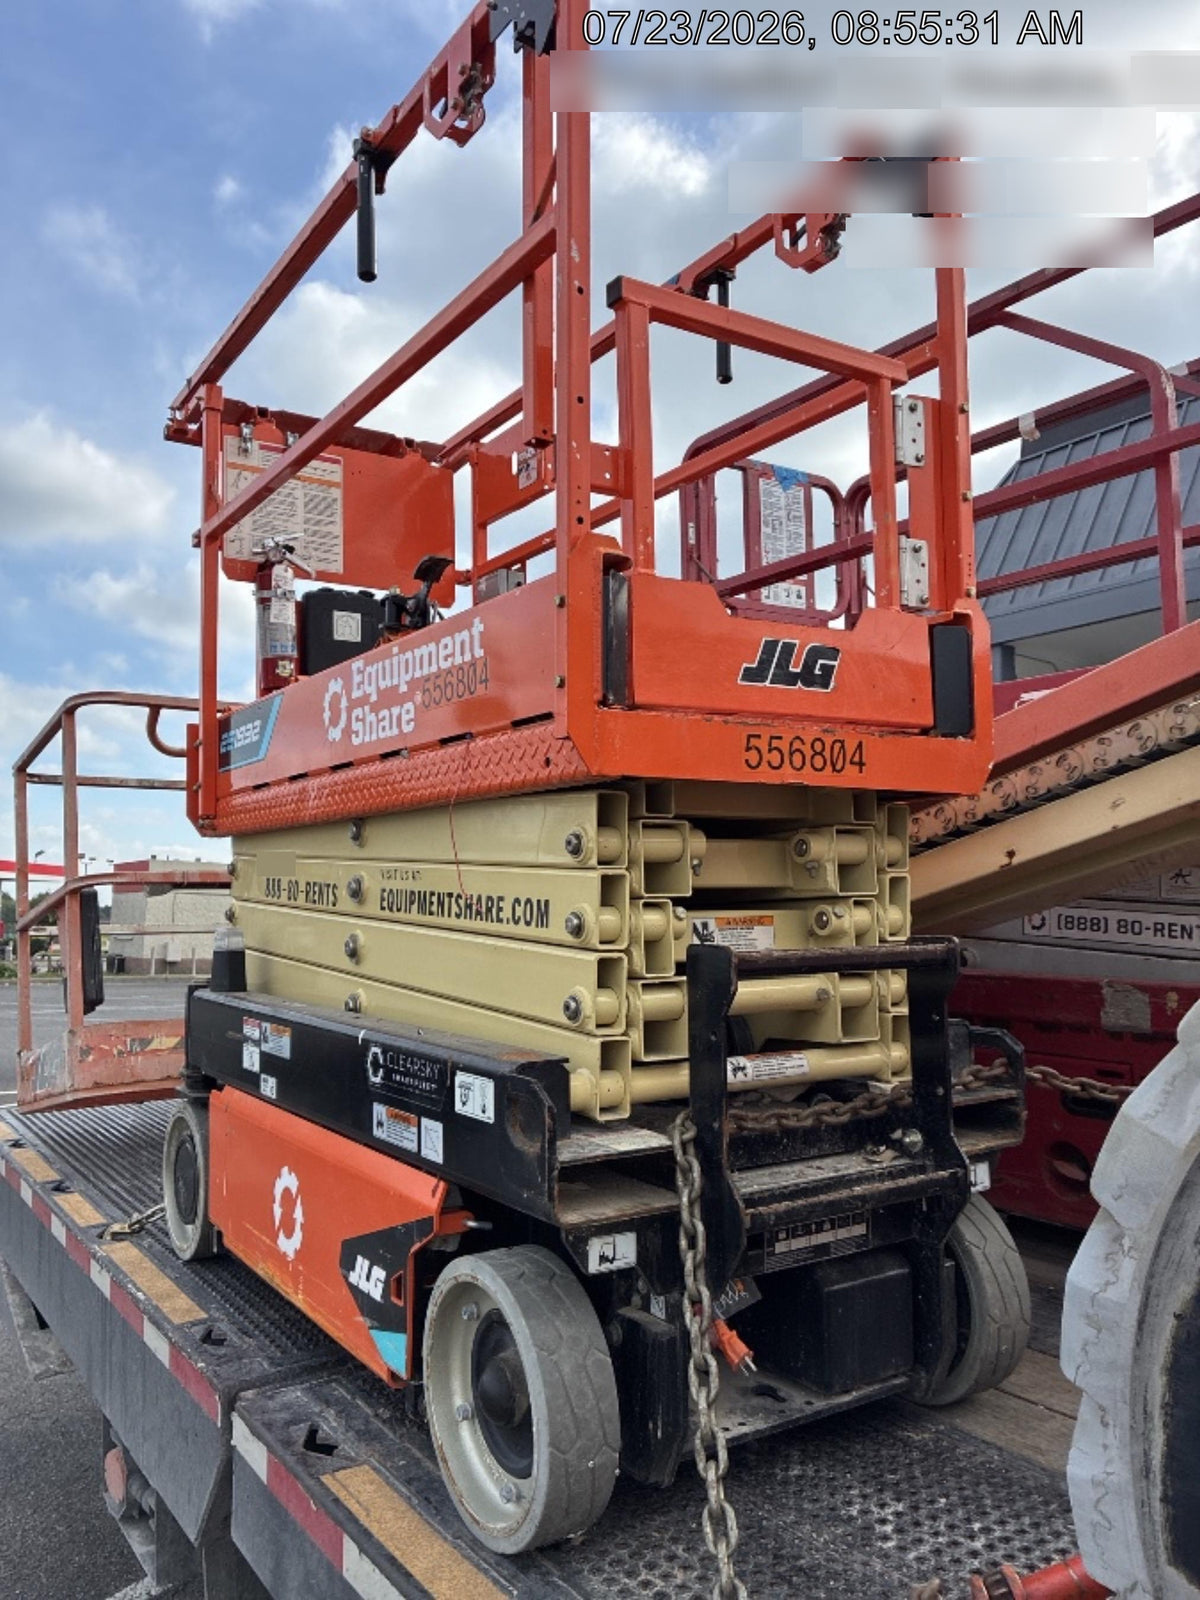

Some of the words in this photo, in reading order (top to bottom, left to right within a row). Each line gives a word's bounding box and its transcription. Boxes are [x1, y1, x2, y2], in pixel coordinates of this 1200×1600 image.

[351, 617, 484, 702] Equipment
[738, 637, 842, 692] JLG
[421, 657, 490, 709] 556804
[351, 701, 415, 745] Share
[744, 733, 866, 774] 556804
[379, 888, 550, 929] EQUIPMENTSHARE.COM
[1057, 913, 1109, 935] (888)
[347, 1254, 387, 1302] JLG
